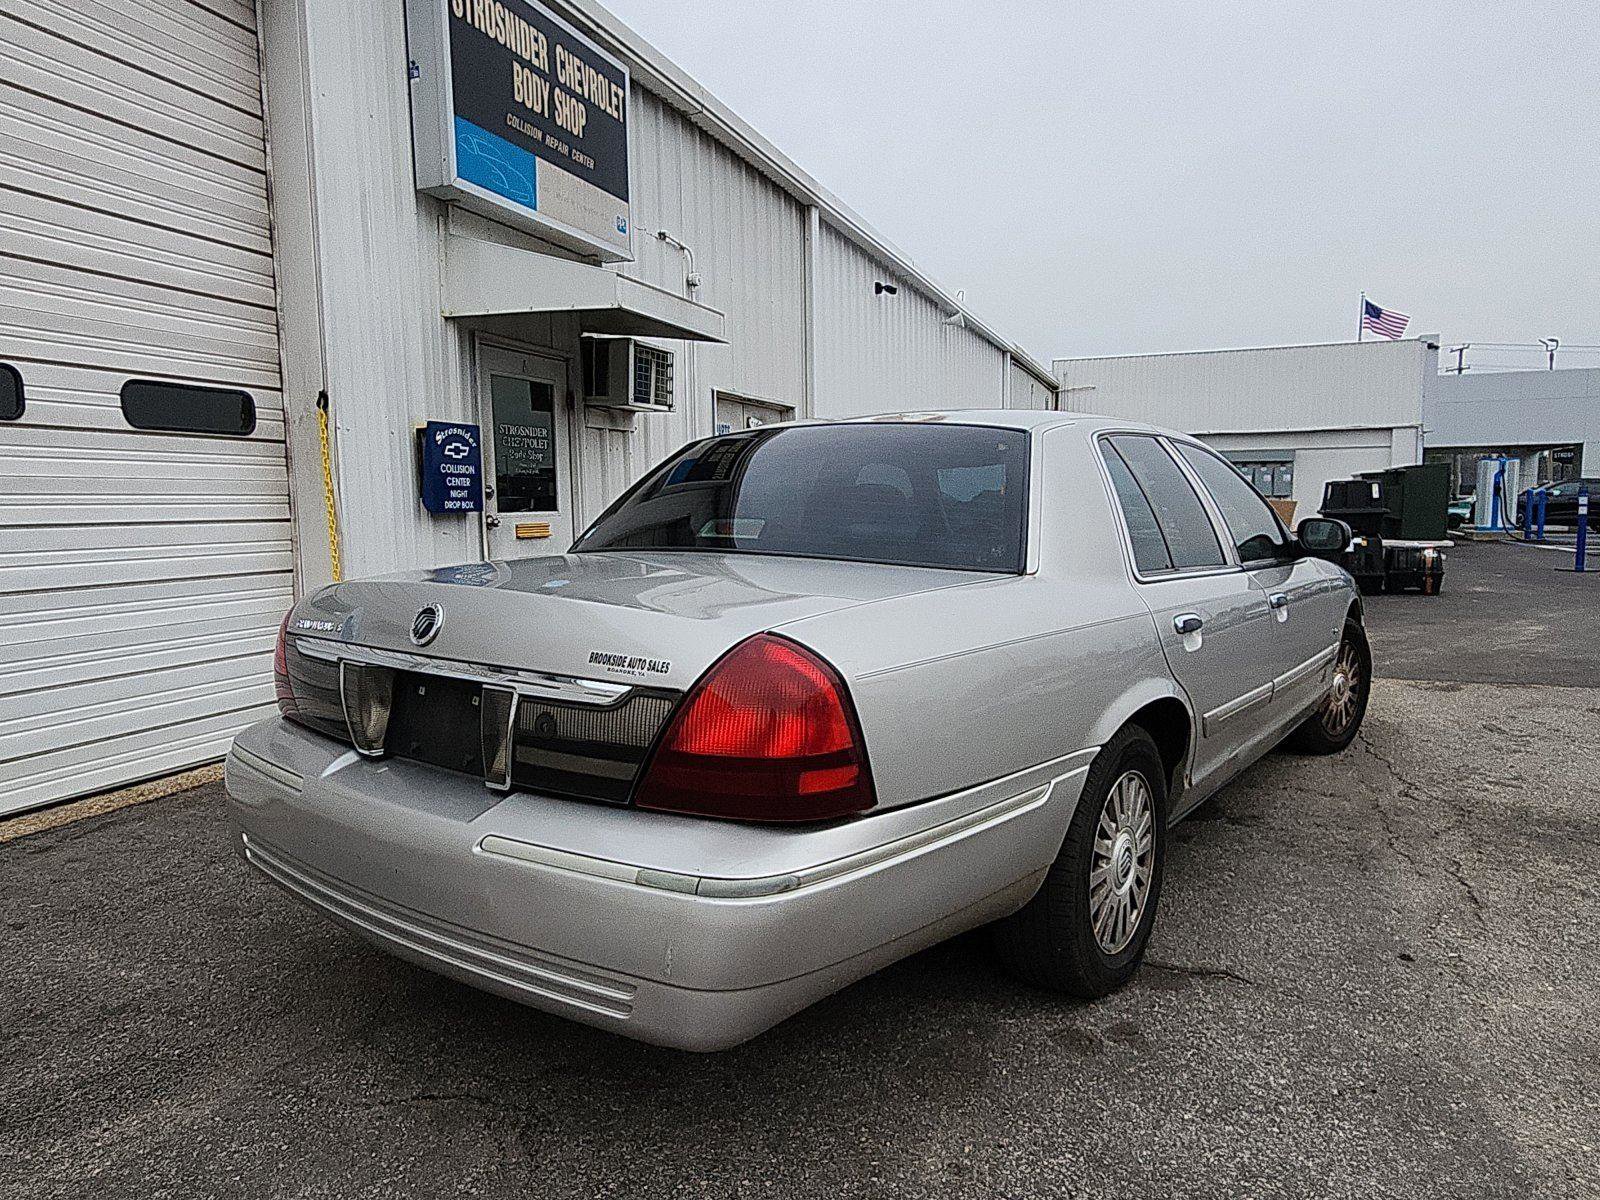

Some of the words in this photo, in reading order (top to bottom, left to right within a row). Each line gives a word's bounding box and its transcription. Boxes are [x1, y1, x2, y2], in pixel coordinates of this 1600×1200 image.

[555, 43, 625, 123] CHEVROLET
[512, 60, 550, 118] BODY
[553, 87, 587, 138] SHOP
[506, 113, 542, 142] COLLISION
[545, 134, 569, 157] REPAIR
[571, 148, 595, 170] CENTER
[435, 427, 477, 448] Strosnider
[499, 424, 548, 437] STROSNIDER
[440, 463, 475, 475] COLLISION
[446, 477, 471, 487] CENTER
[450, 489, 468, 498] NIGHT
[444, 500, 461, 509] DROP
[461, 500, 474, 509] BOX
[588, 651, 628, 668] BROOKSIDE
[627, 657, 647, 670] AUTO
[647, 660, 671, 674] SALES
